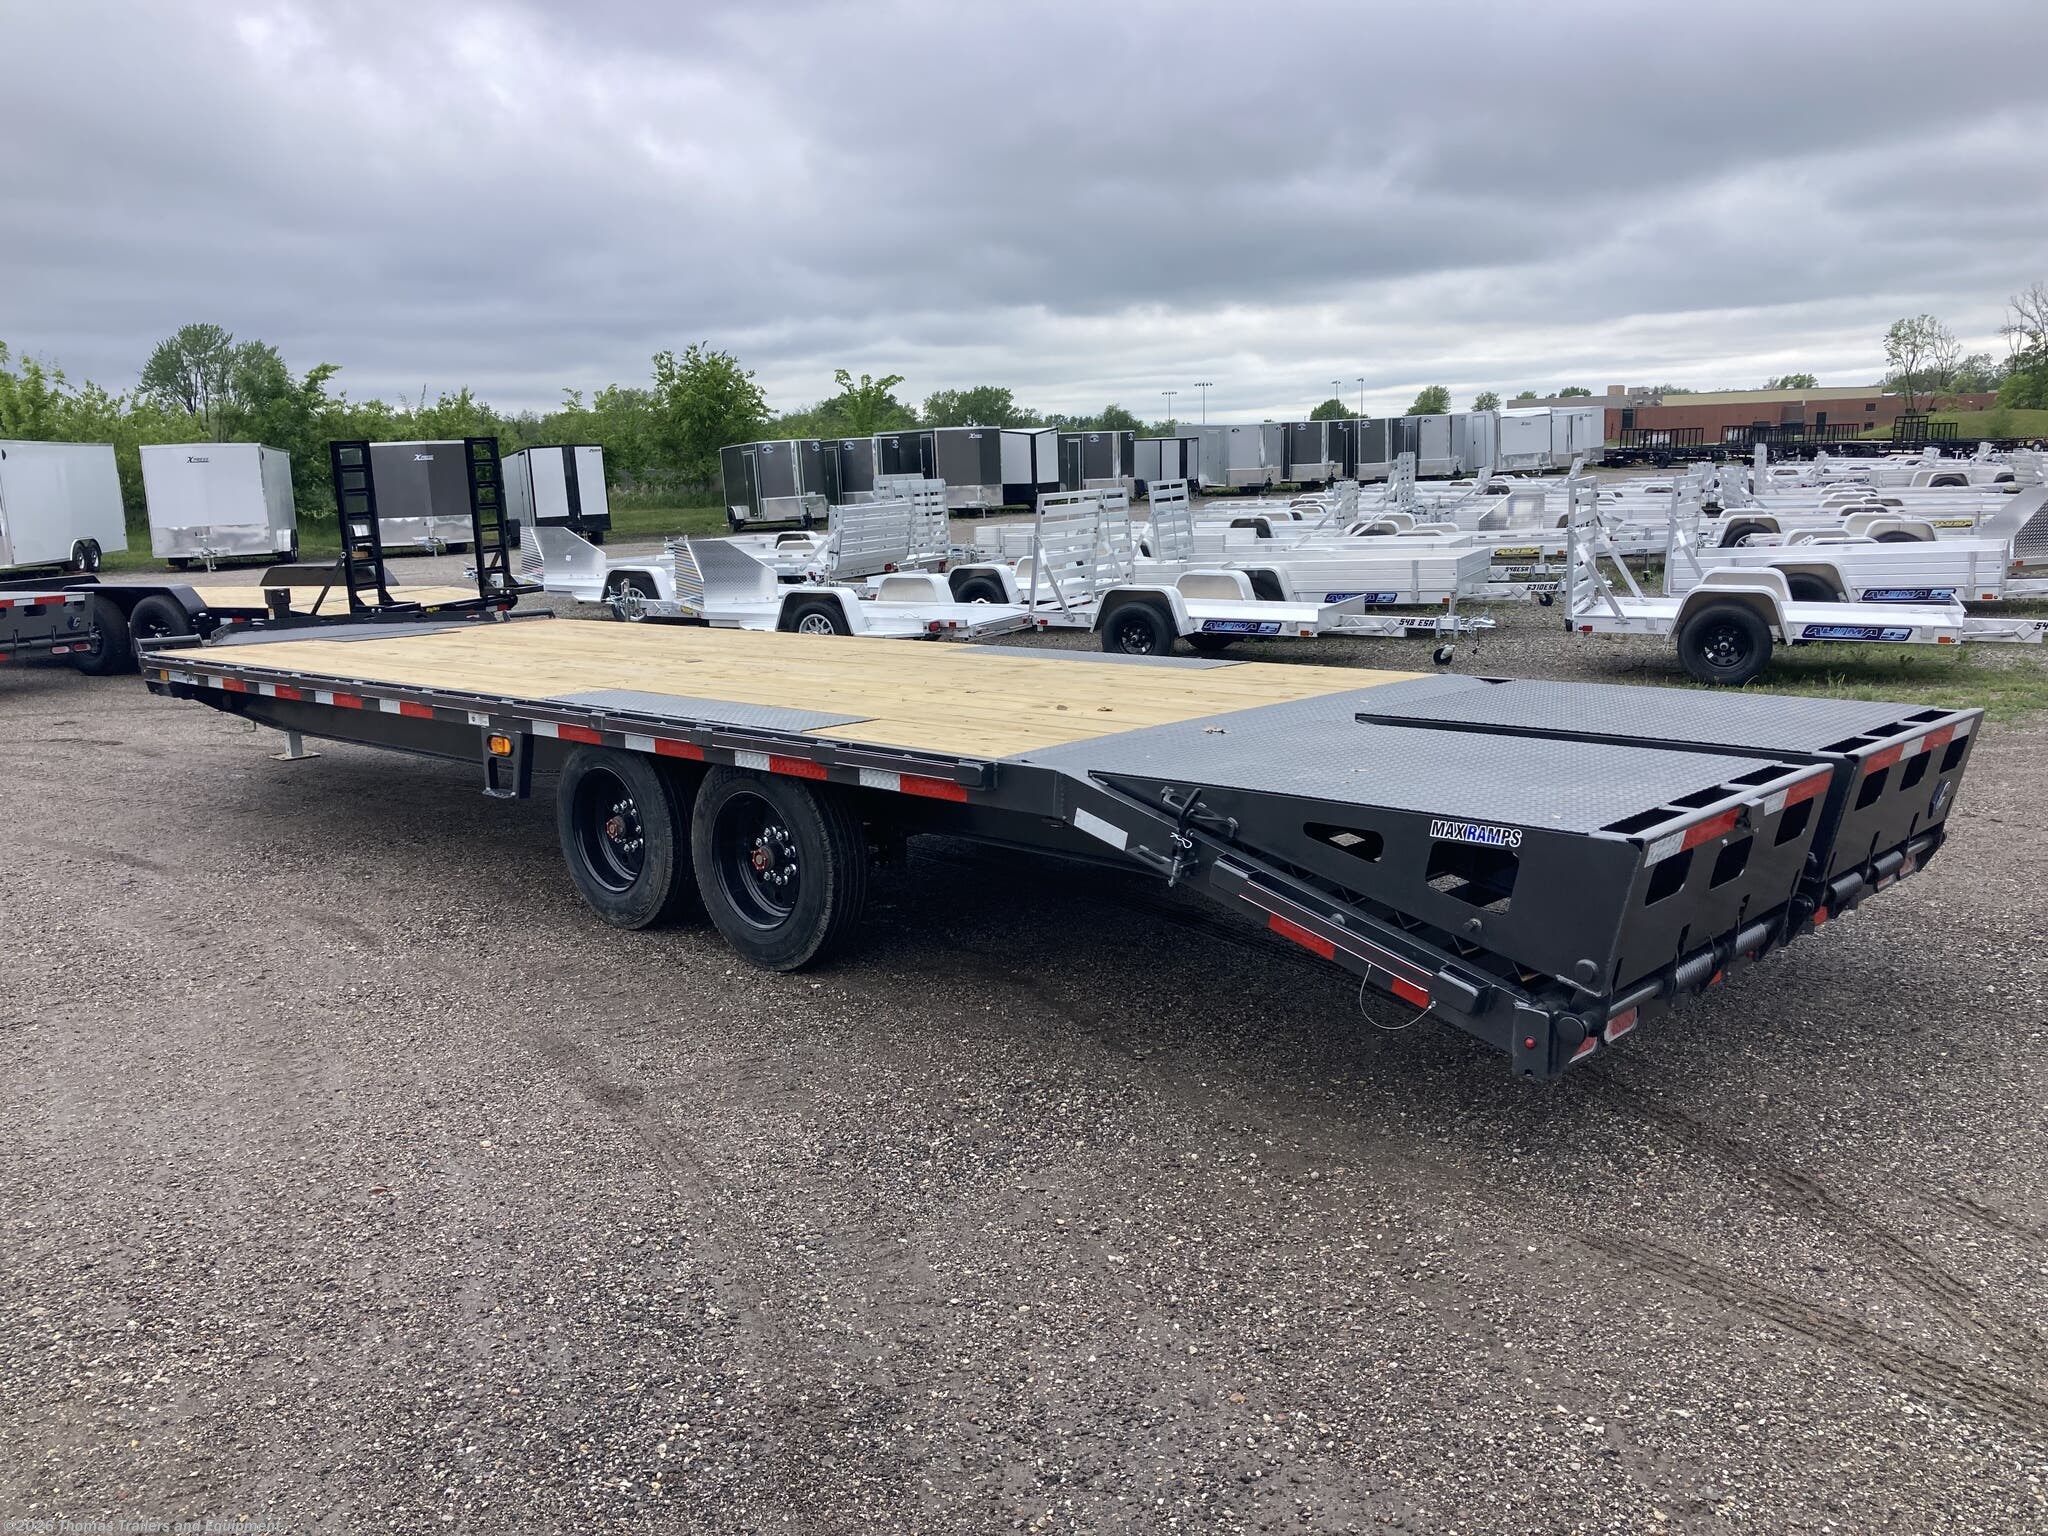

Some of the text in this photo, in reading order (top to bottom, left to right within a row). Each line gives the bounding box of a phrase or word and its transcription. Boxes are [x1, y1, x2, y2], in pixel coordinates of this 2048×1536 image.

[1864, 590, 1928, 600] ALUMA
[1203, 621, 1258, 632] ALUMA
[1398, 618, 1416, 626] 548
[1805, 626, 1879, 638] ALUMA
[1430, 820, 1523, 848] MAXRAMPS
